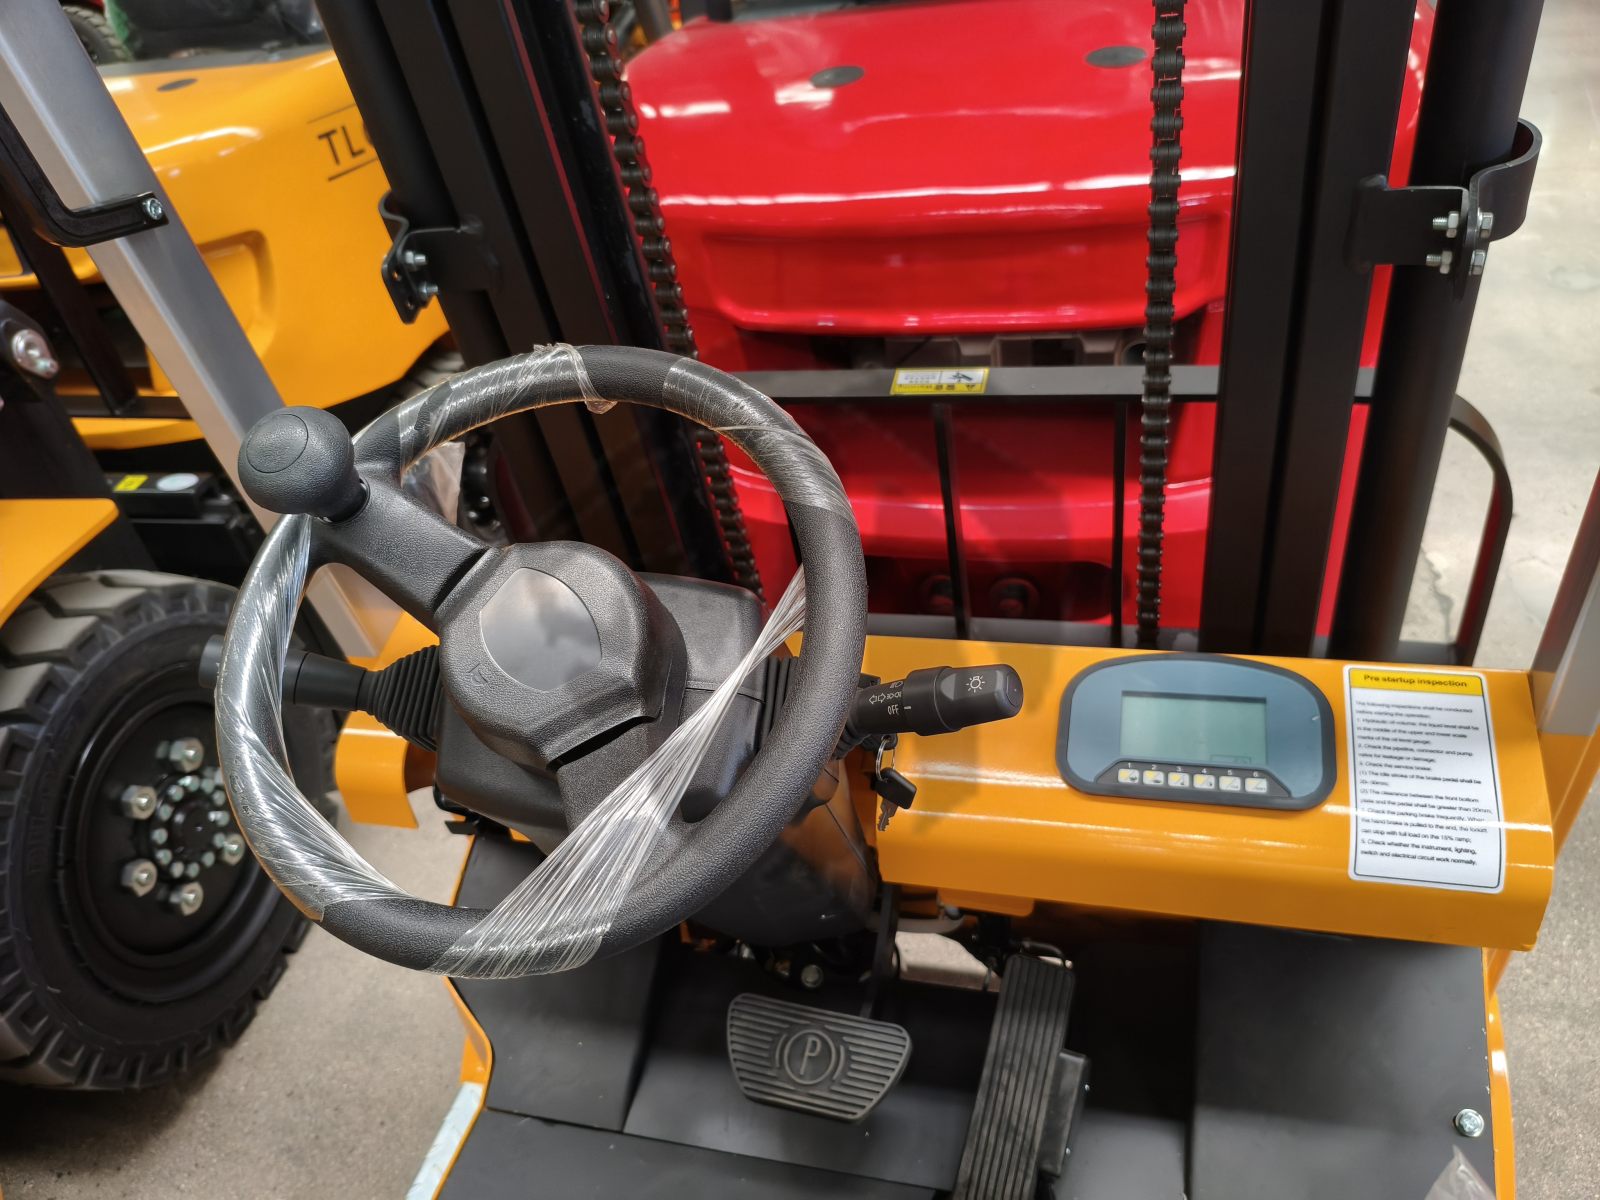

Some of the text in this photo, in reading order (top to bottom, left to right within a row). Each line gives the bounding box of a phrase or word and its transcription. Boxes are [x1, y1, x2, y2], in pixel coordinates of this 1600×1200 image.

[1364, 674, 1468, 687] Pre startup inspection
[887, 704, 899, 715] OFF
[799, 1034, 822, 1075] P
